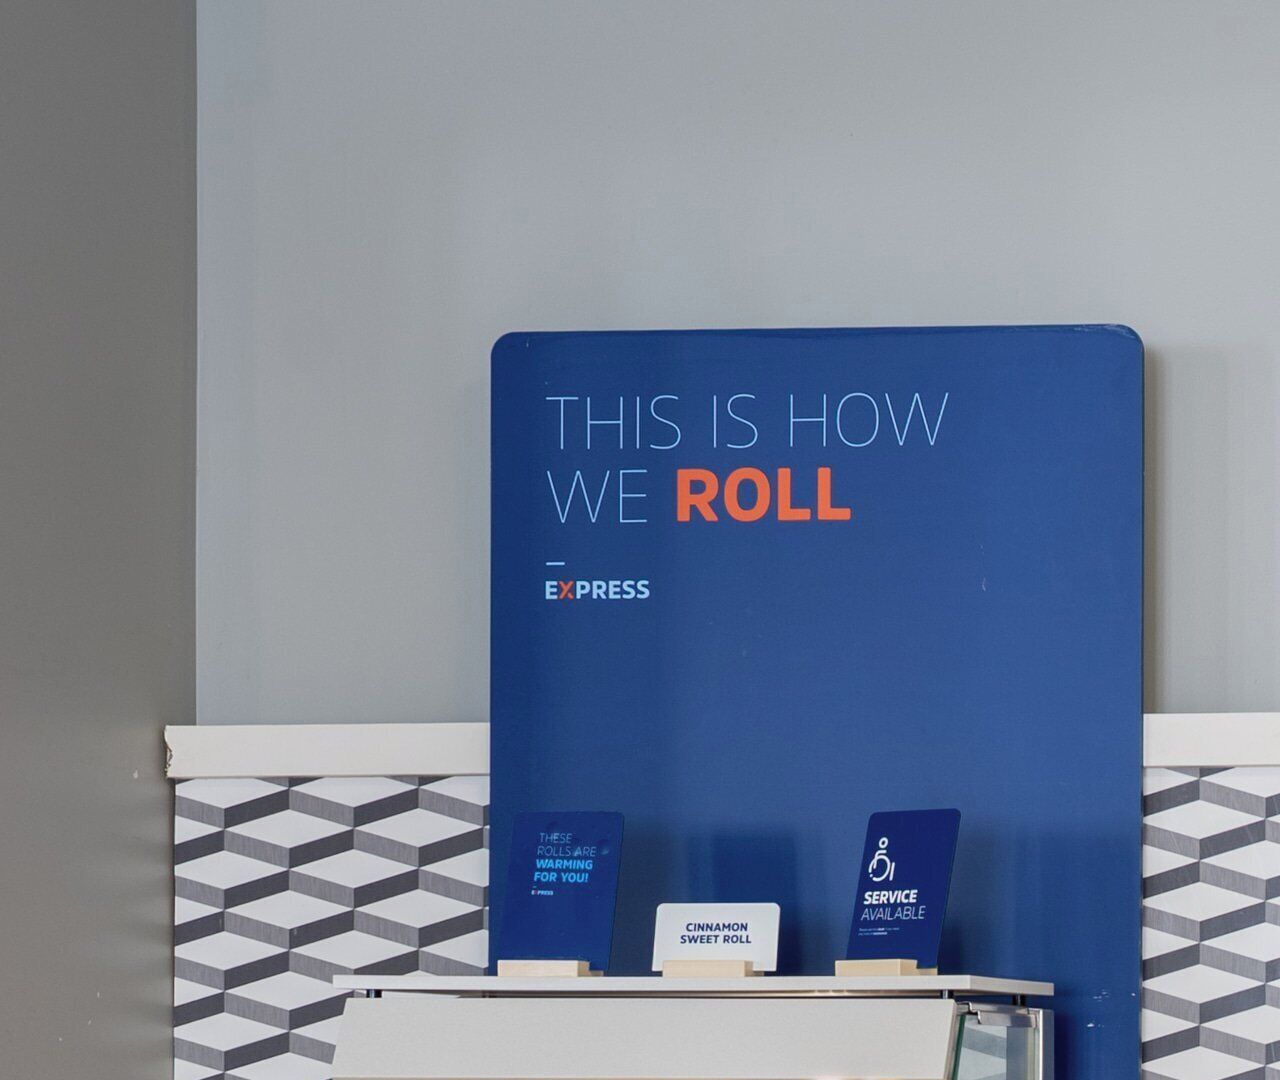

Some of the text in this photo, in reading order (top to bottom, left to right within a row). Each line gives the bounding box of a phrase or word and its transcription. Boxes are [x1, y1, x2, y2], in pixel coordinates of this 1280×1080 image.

[545, 391, 949, 450] THIS IS HOW
[546, 466, 852, 524] WE ROLL
[545, 579, 650, 600] EXPRESS
[539, 832, 573, 844] THESE
[537, 845, 597, 857] ROLLS ARE
[536, 858, 593, 870] WARMING
[533, 871, 589, 883] FOR YOU!
[863, 889, 918, 905] SERVICE
[860, 905, 926, 921] AVAILABLE
[685, 922, 748, 933] CINNAMON
[680, 934, 752, 945] SWEET ROLL
